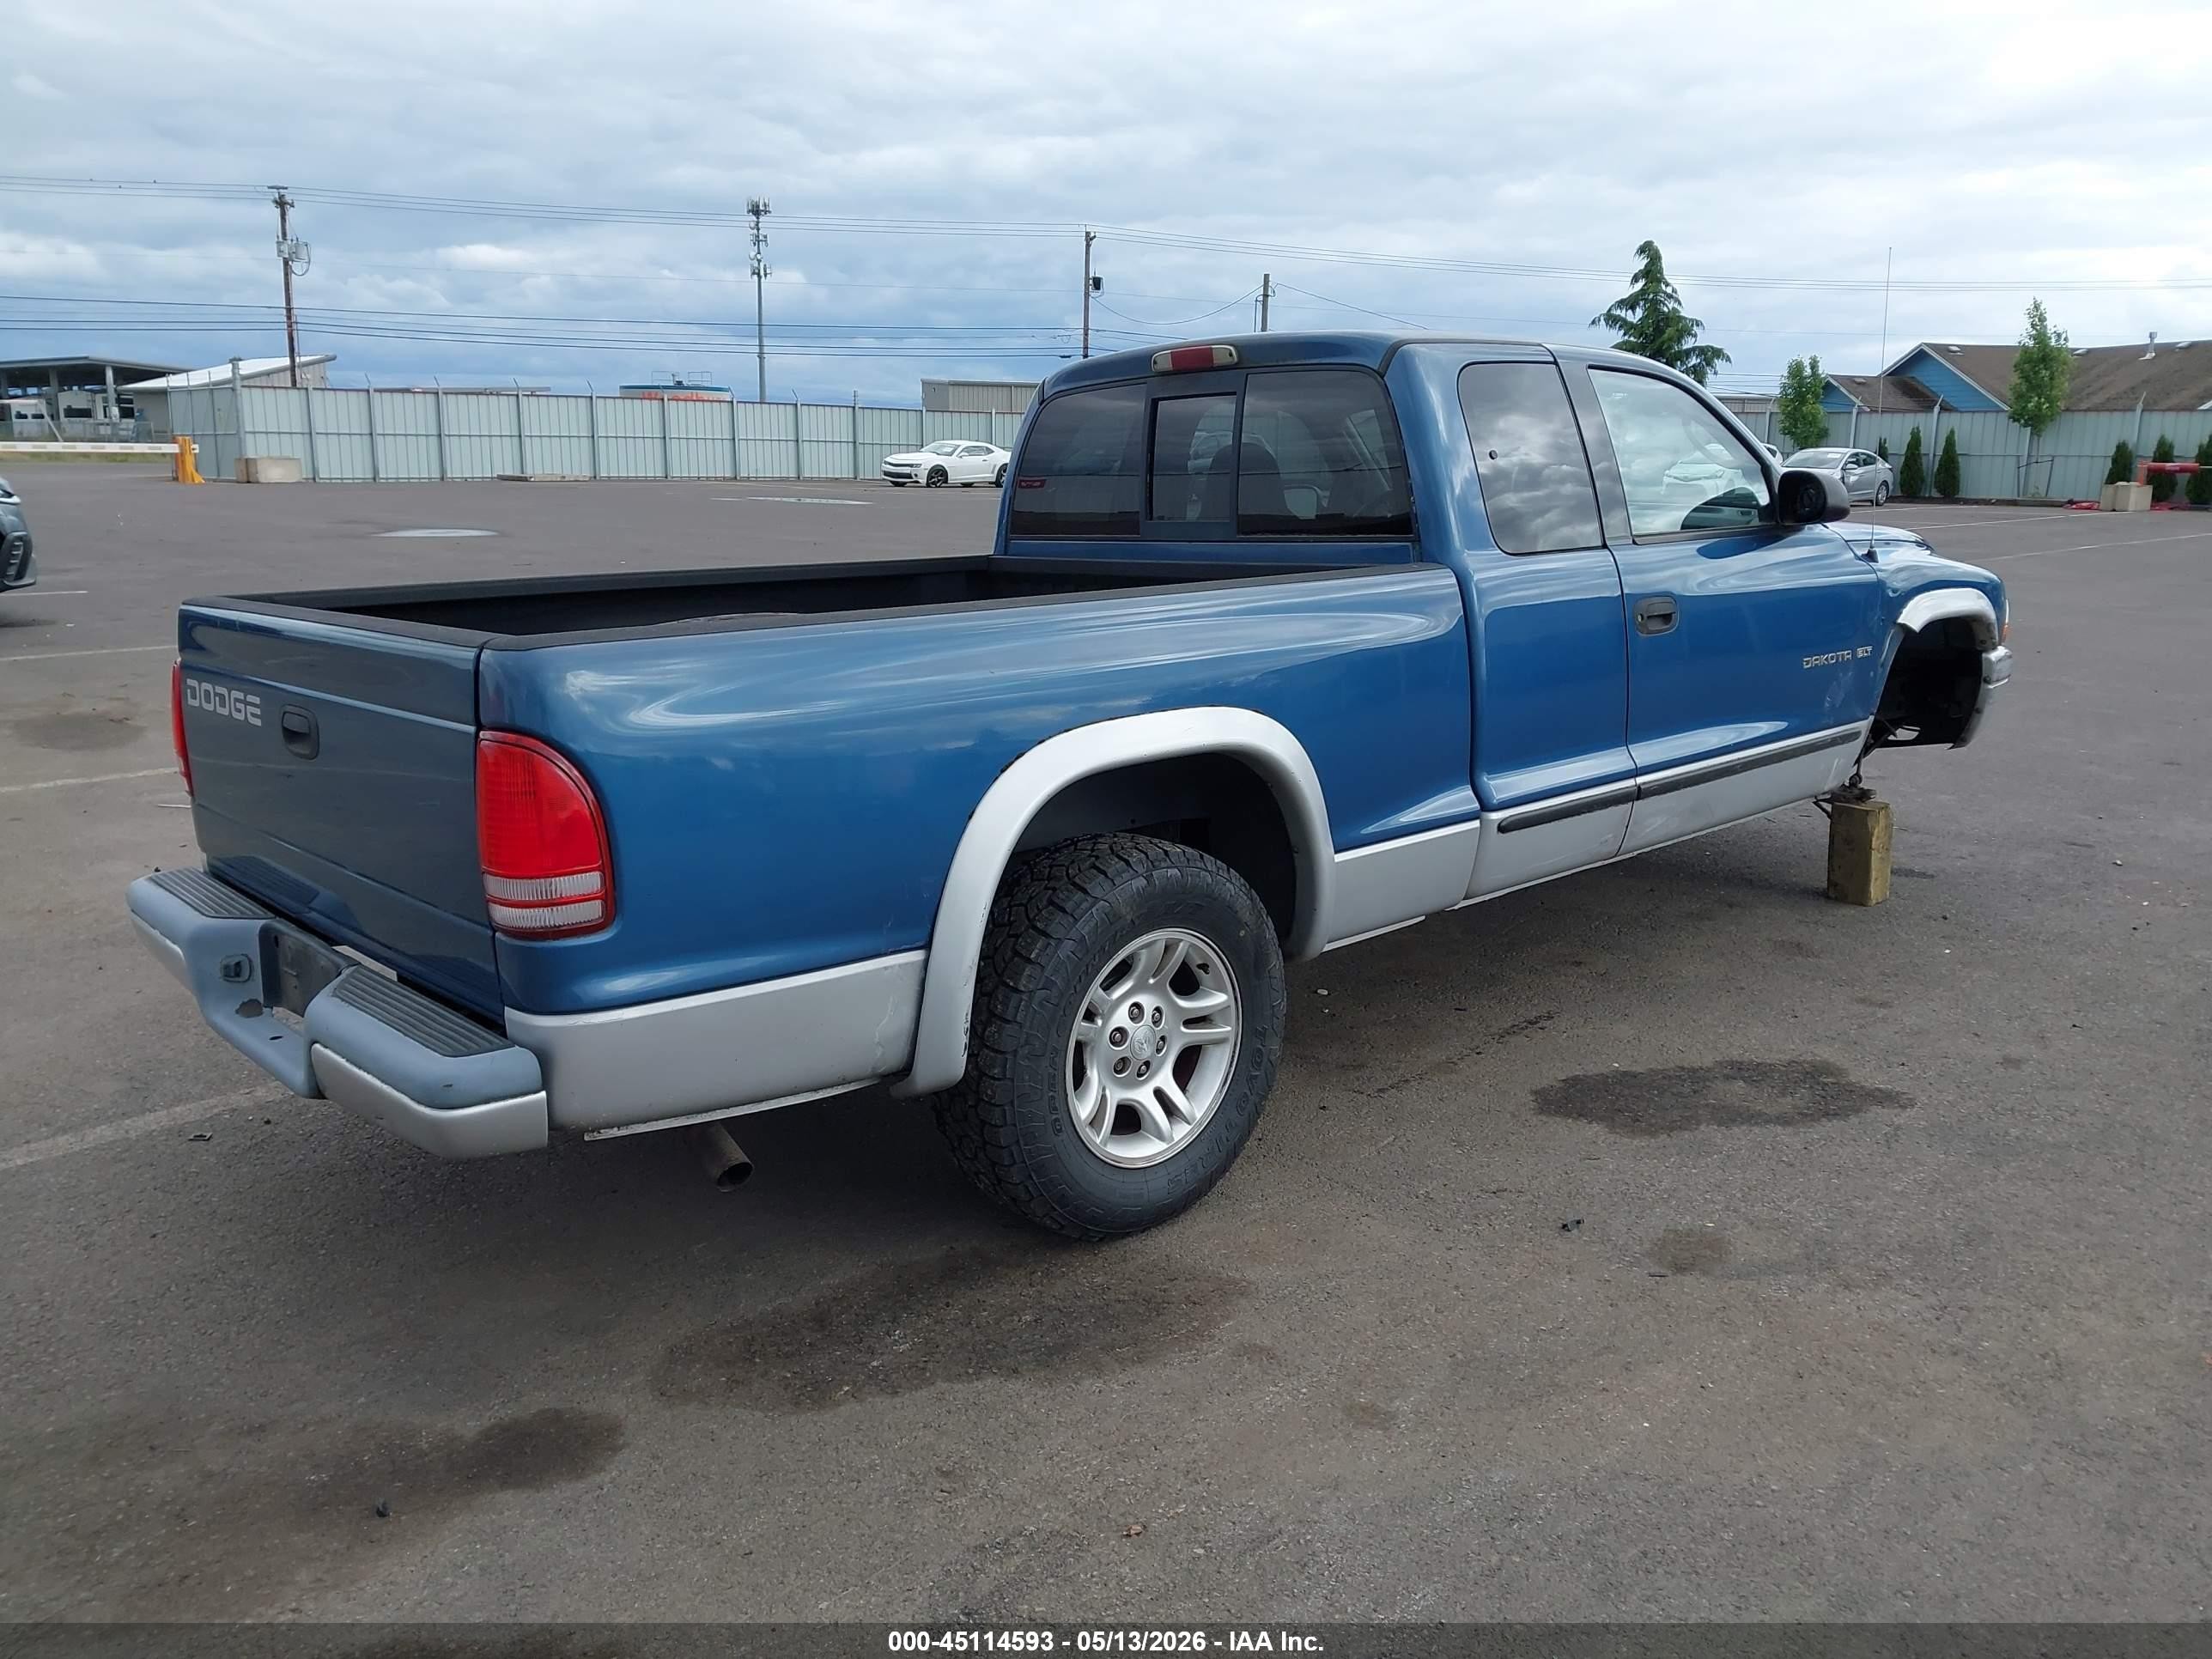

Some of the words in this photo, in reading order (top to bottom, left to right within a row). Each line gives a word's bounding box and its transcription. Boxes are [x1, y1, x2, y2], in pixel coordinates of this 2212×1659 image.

[1802, 650, 1852, 669] DAKOTA
[1856, 646, 1873, 659] SLT
[185, 678, 262, 726] DODGE
[1234, 1024, 1268, 1117] TOYO
